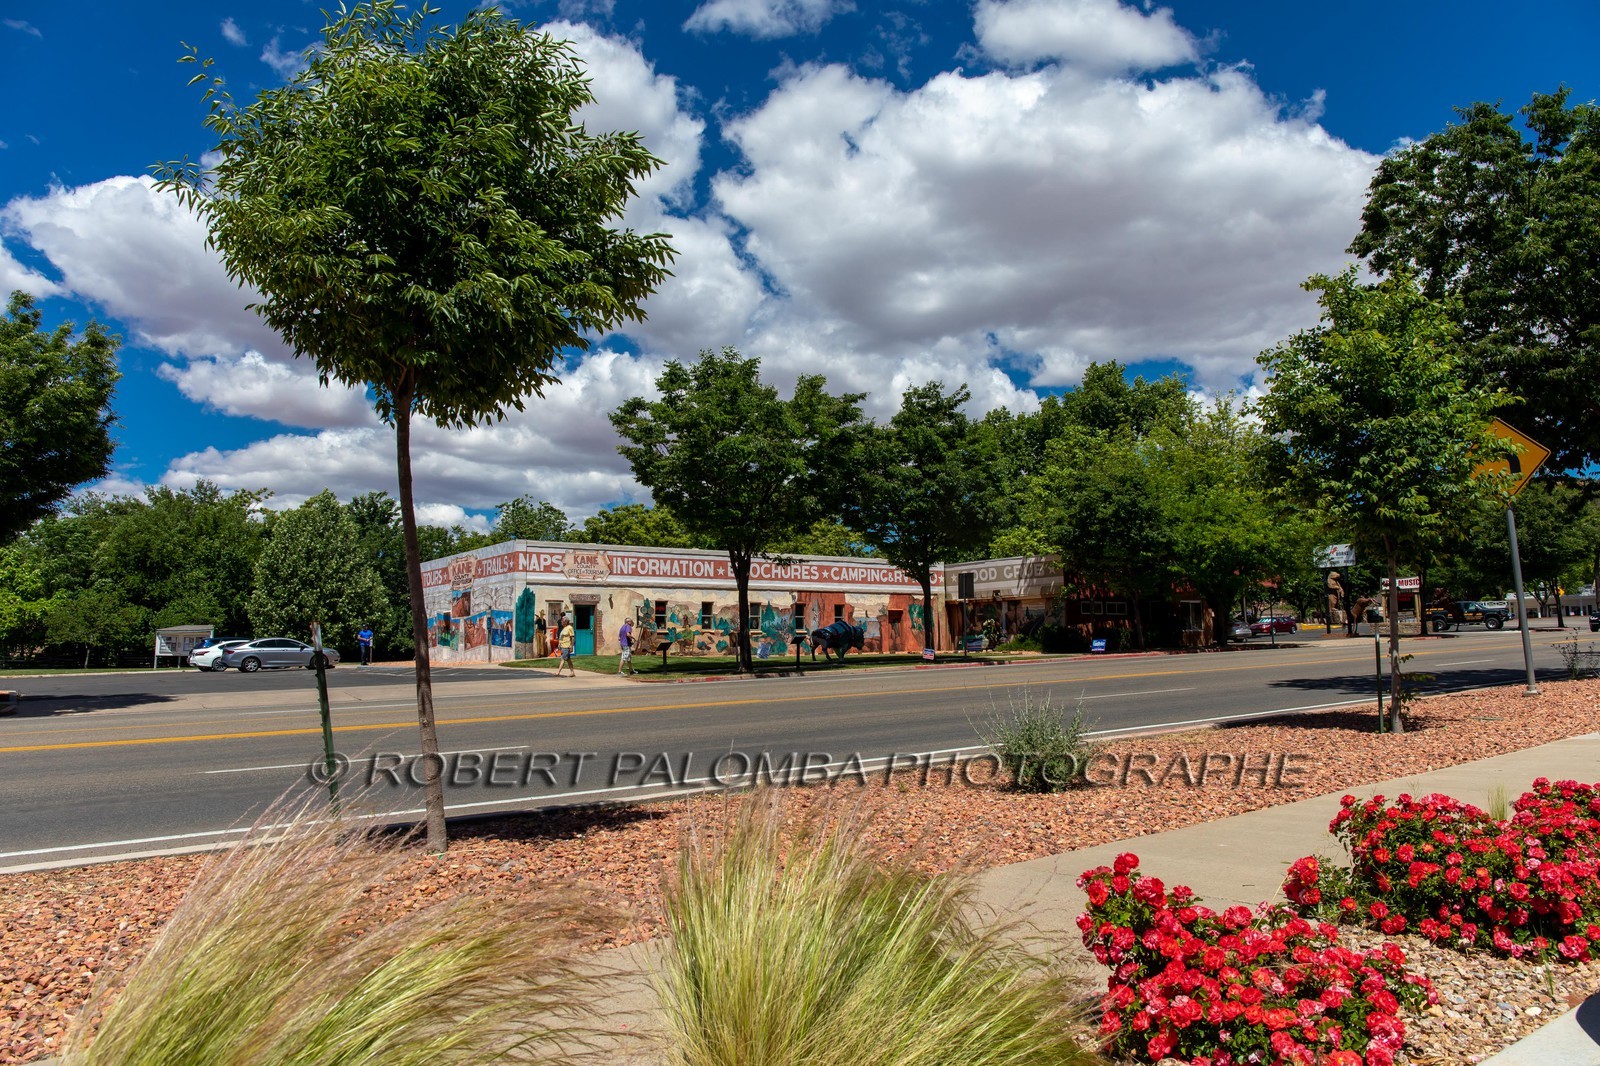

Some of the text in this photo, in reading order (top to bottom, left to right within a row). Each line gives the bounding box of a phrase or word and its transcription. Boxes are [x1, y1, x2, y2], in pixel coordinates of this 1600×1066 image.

[452, 561, 472, 576] KANE
[518, 553, 563, 572] MAPS
[612, 557, 714, 577] INFORMATION
[727, 562, 819, 580] BOCHURES
[573, 555, 599, 565] KANE
[423, 570, 442, 587] TOURS
[482, 555, 508, 575] TRAILS
